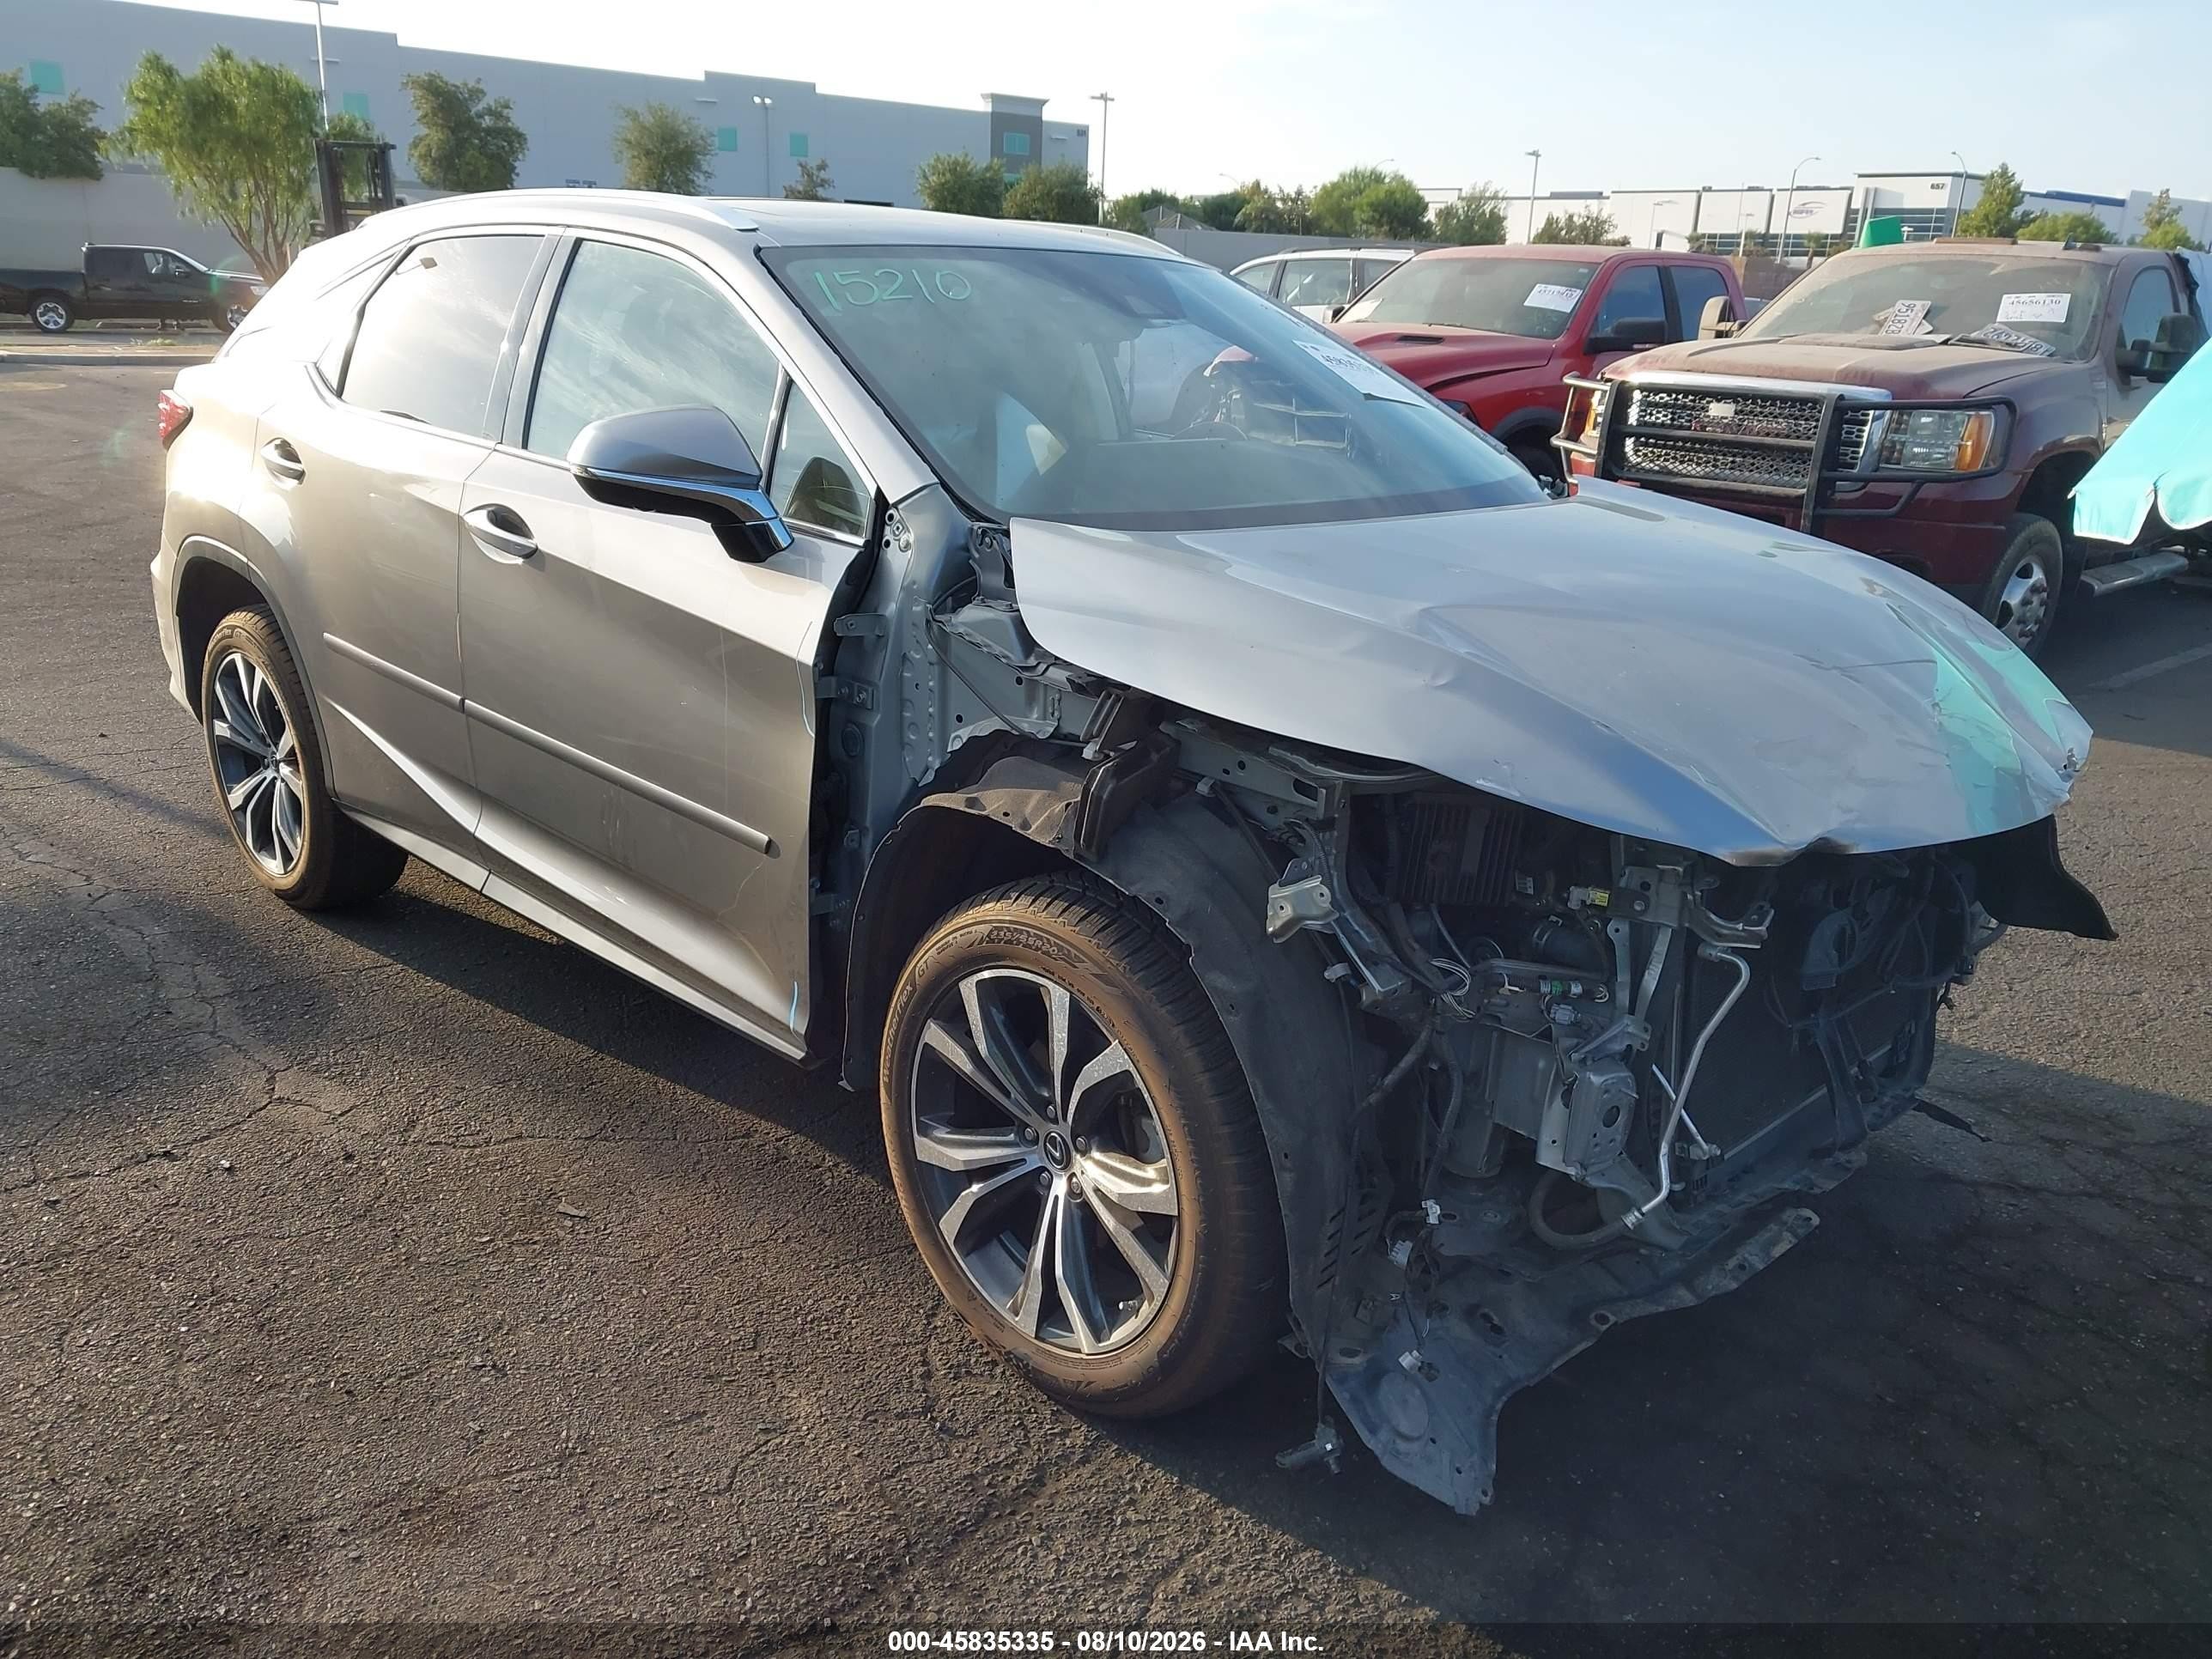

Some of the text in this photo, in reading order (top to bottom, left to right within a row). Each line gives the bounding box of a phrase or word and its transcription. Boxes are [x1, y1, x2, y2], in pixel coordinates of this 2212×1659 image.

[814, 268, 972, 311] 15210
[883, 959, 931, 1085] Weatherflex GT
